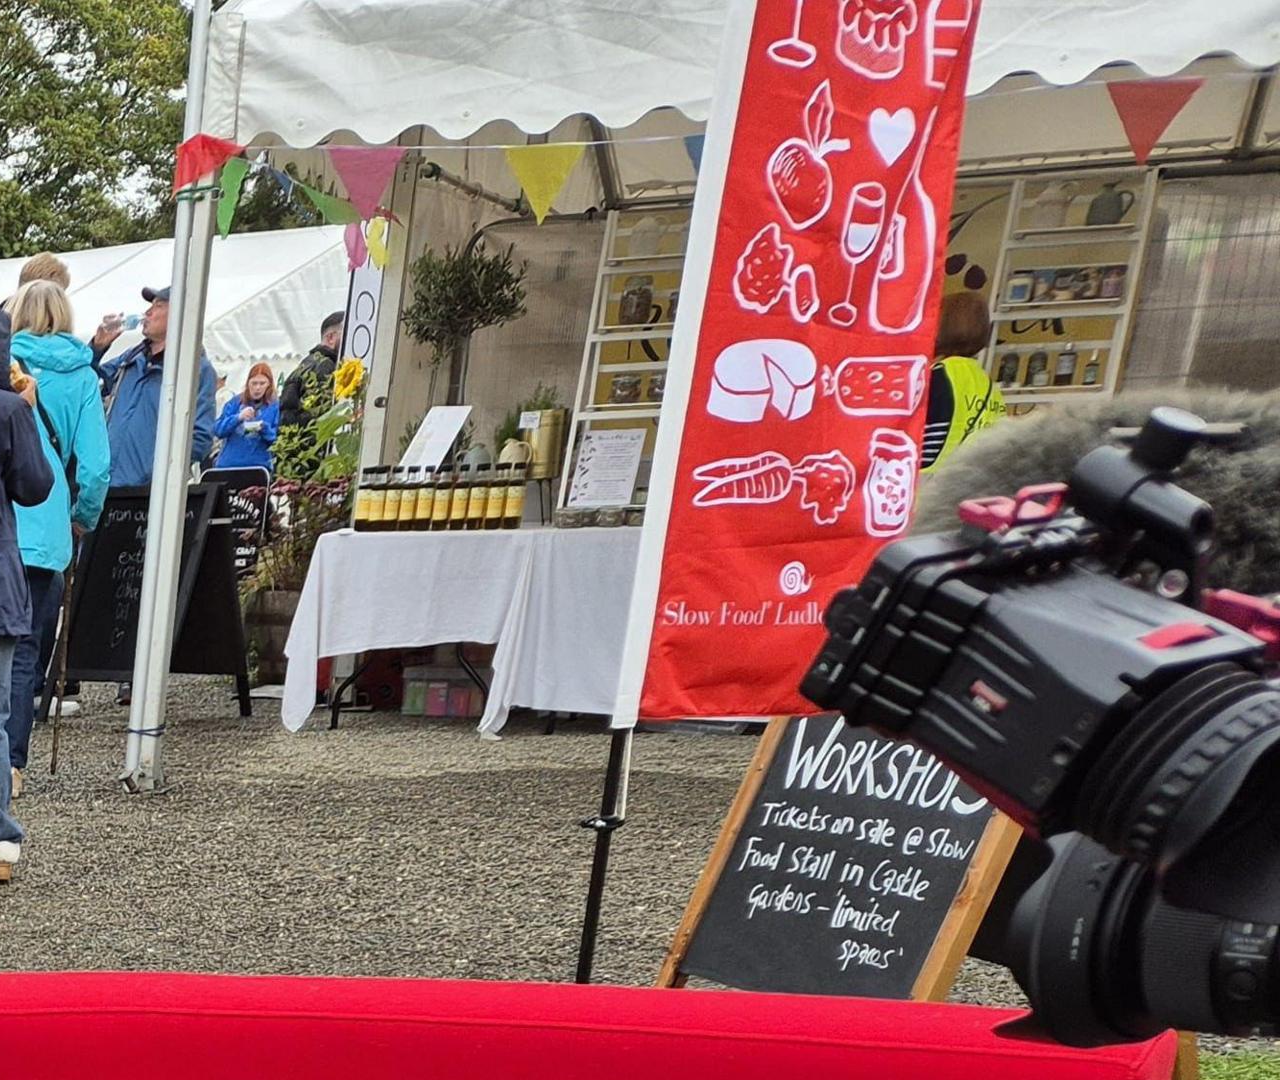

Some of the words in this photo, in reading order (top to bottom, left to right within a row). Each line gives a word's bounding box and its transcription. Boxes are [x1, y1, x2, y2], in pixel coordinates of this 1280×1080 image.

[352, 291, 375, 359] CO
[662, 600, 715, 625] Slow
[775, 602, 825, 625] Ludl
[760, 801, 834, 832] Tickets
[830, 814, 855, 836] on
[856, 818, 896, 848] sale
[902, 826, 924, 856] @
[738, 837, 785, 871] Food
[787, 846, 836, 881] Stall
[840, 857, 864, 887] in
[869, 859, 930, 901] Castle
